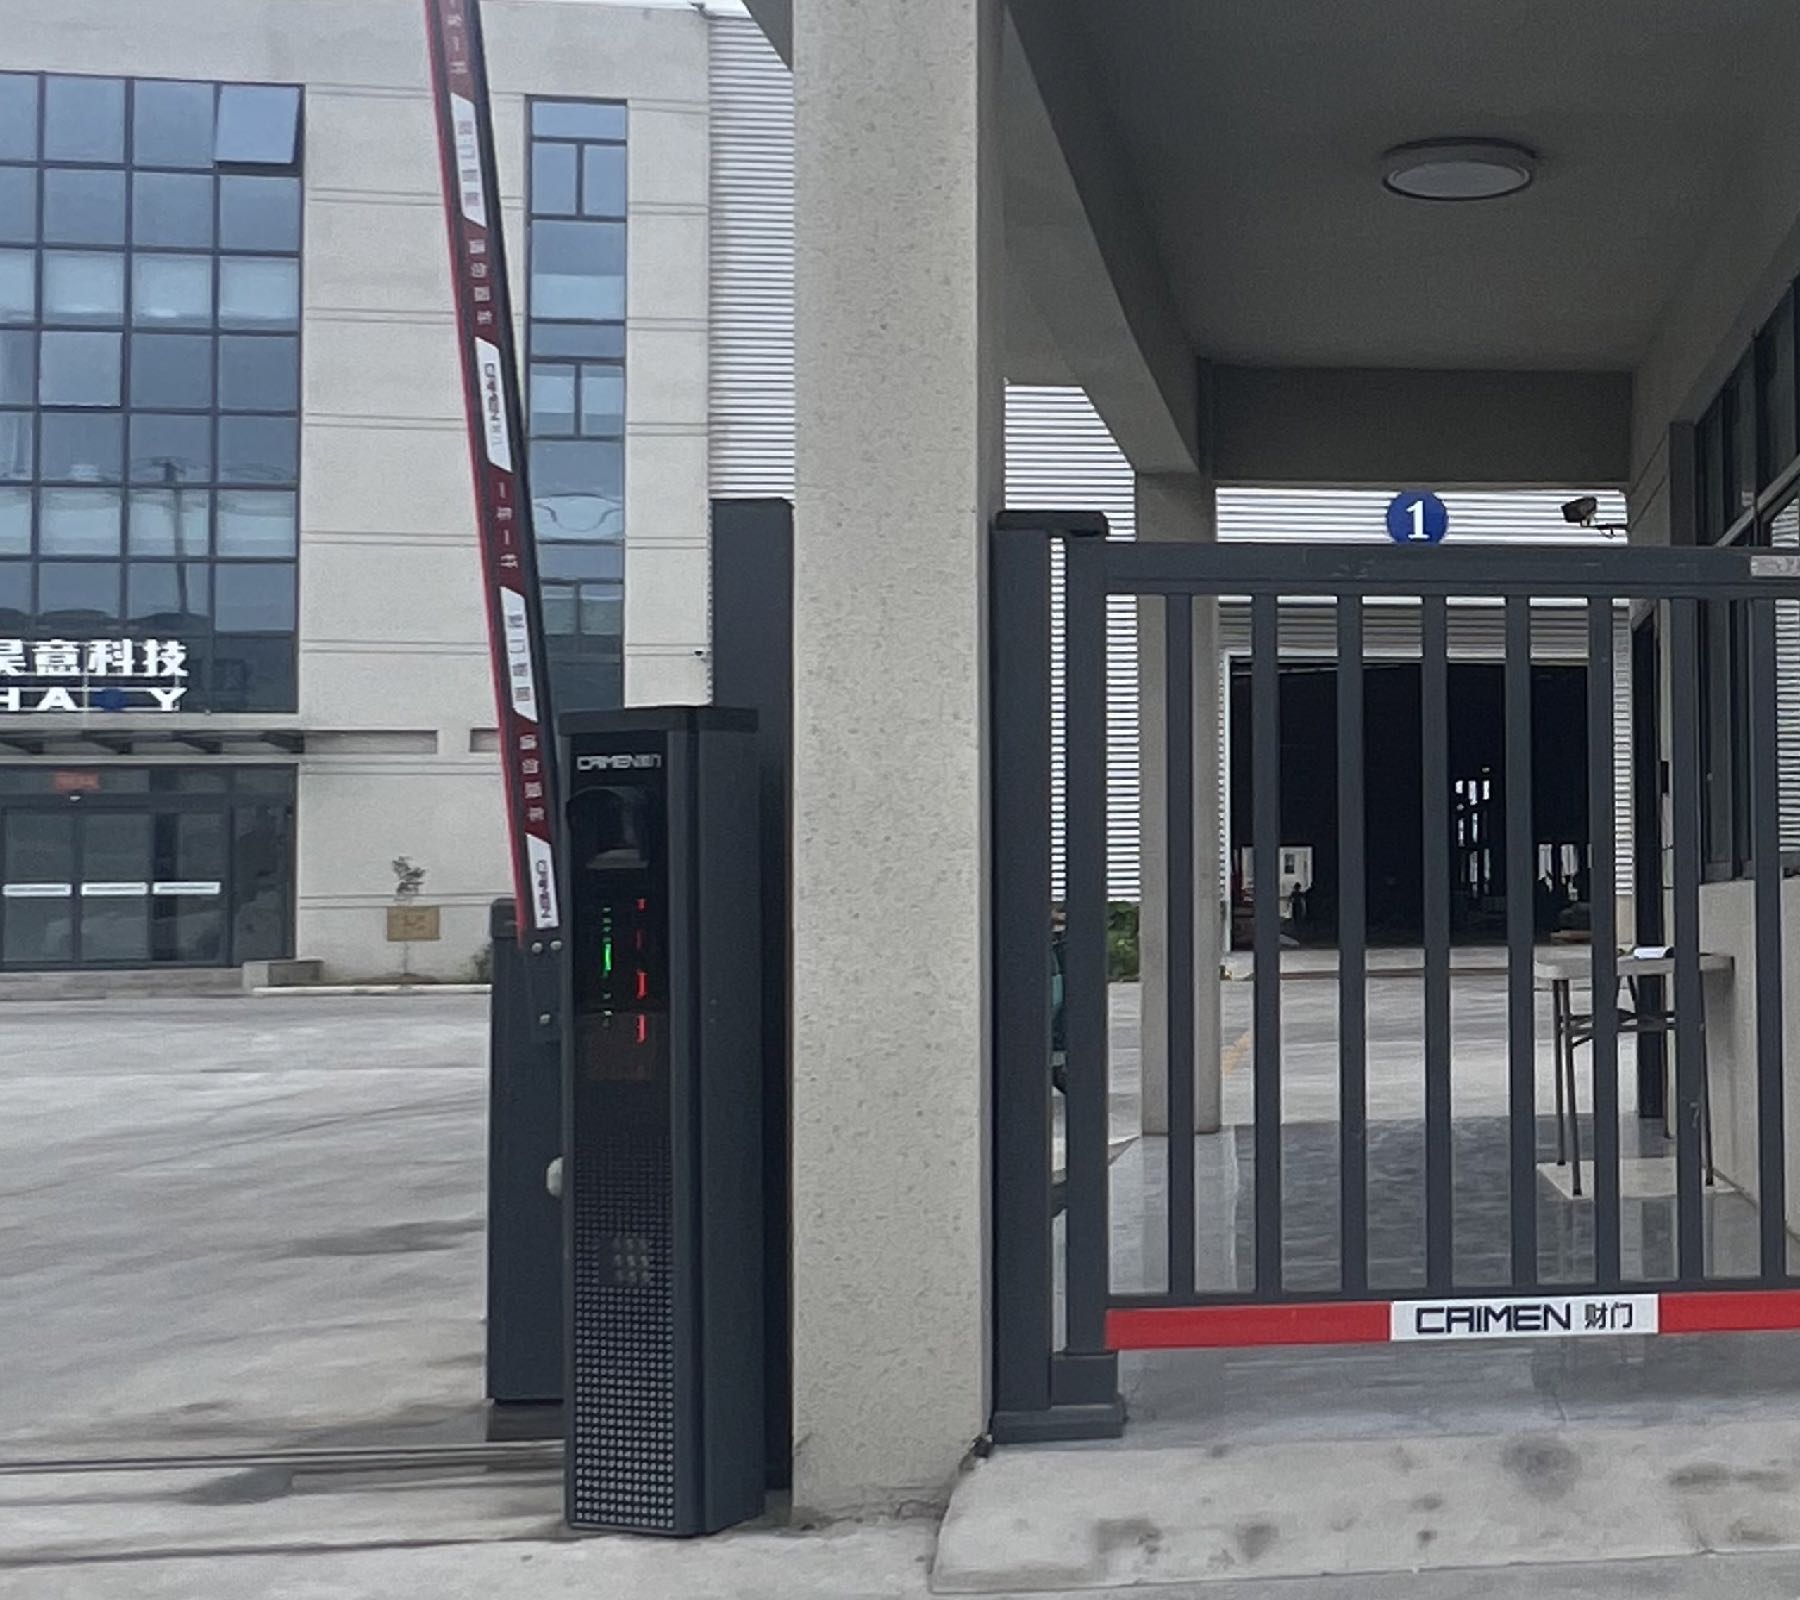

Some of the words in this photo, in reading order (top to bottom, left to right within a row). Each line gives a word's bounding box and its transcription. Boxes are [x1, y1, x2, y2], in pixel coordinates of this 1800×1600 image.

[1406, 500, 1431, 539] 1
[1415, 1302, 1572, 1334] CAIMEN
[1584, 1301, 1634, 1330] 财门
